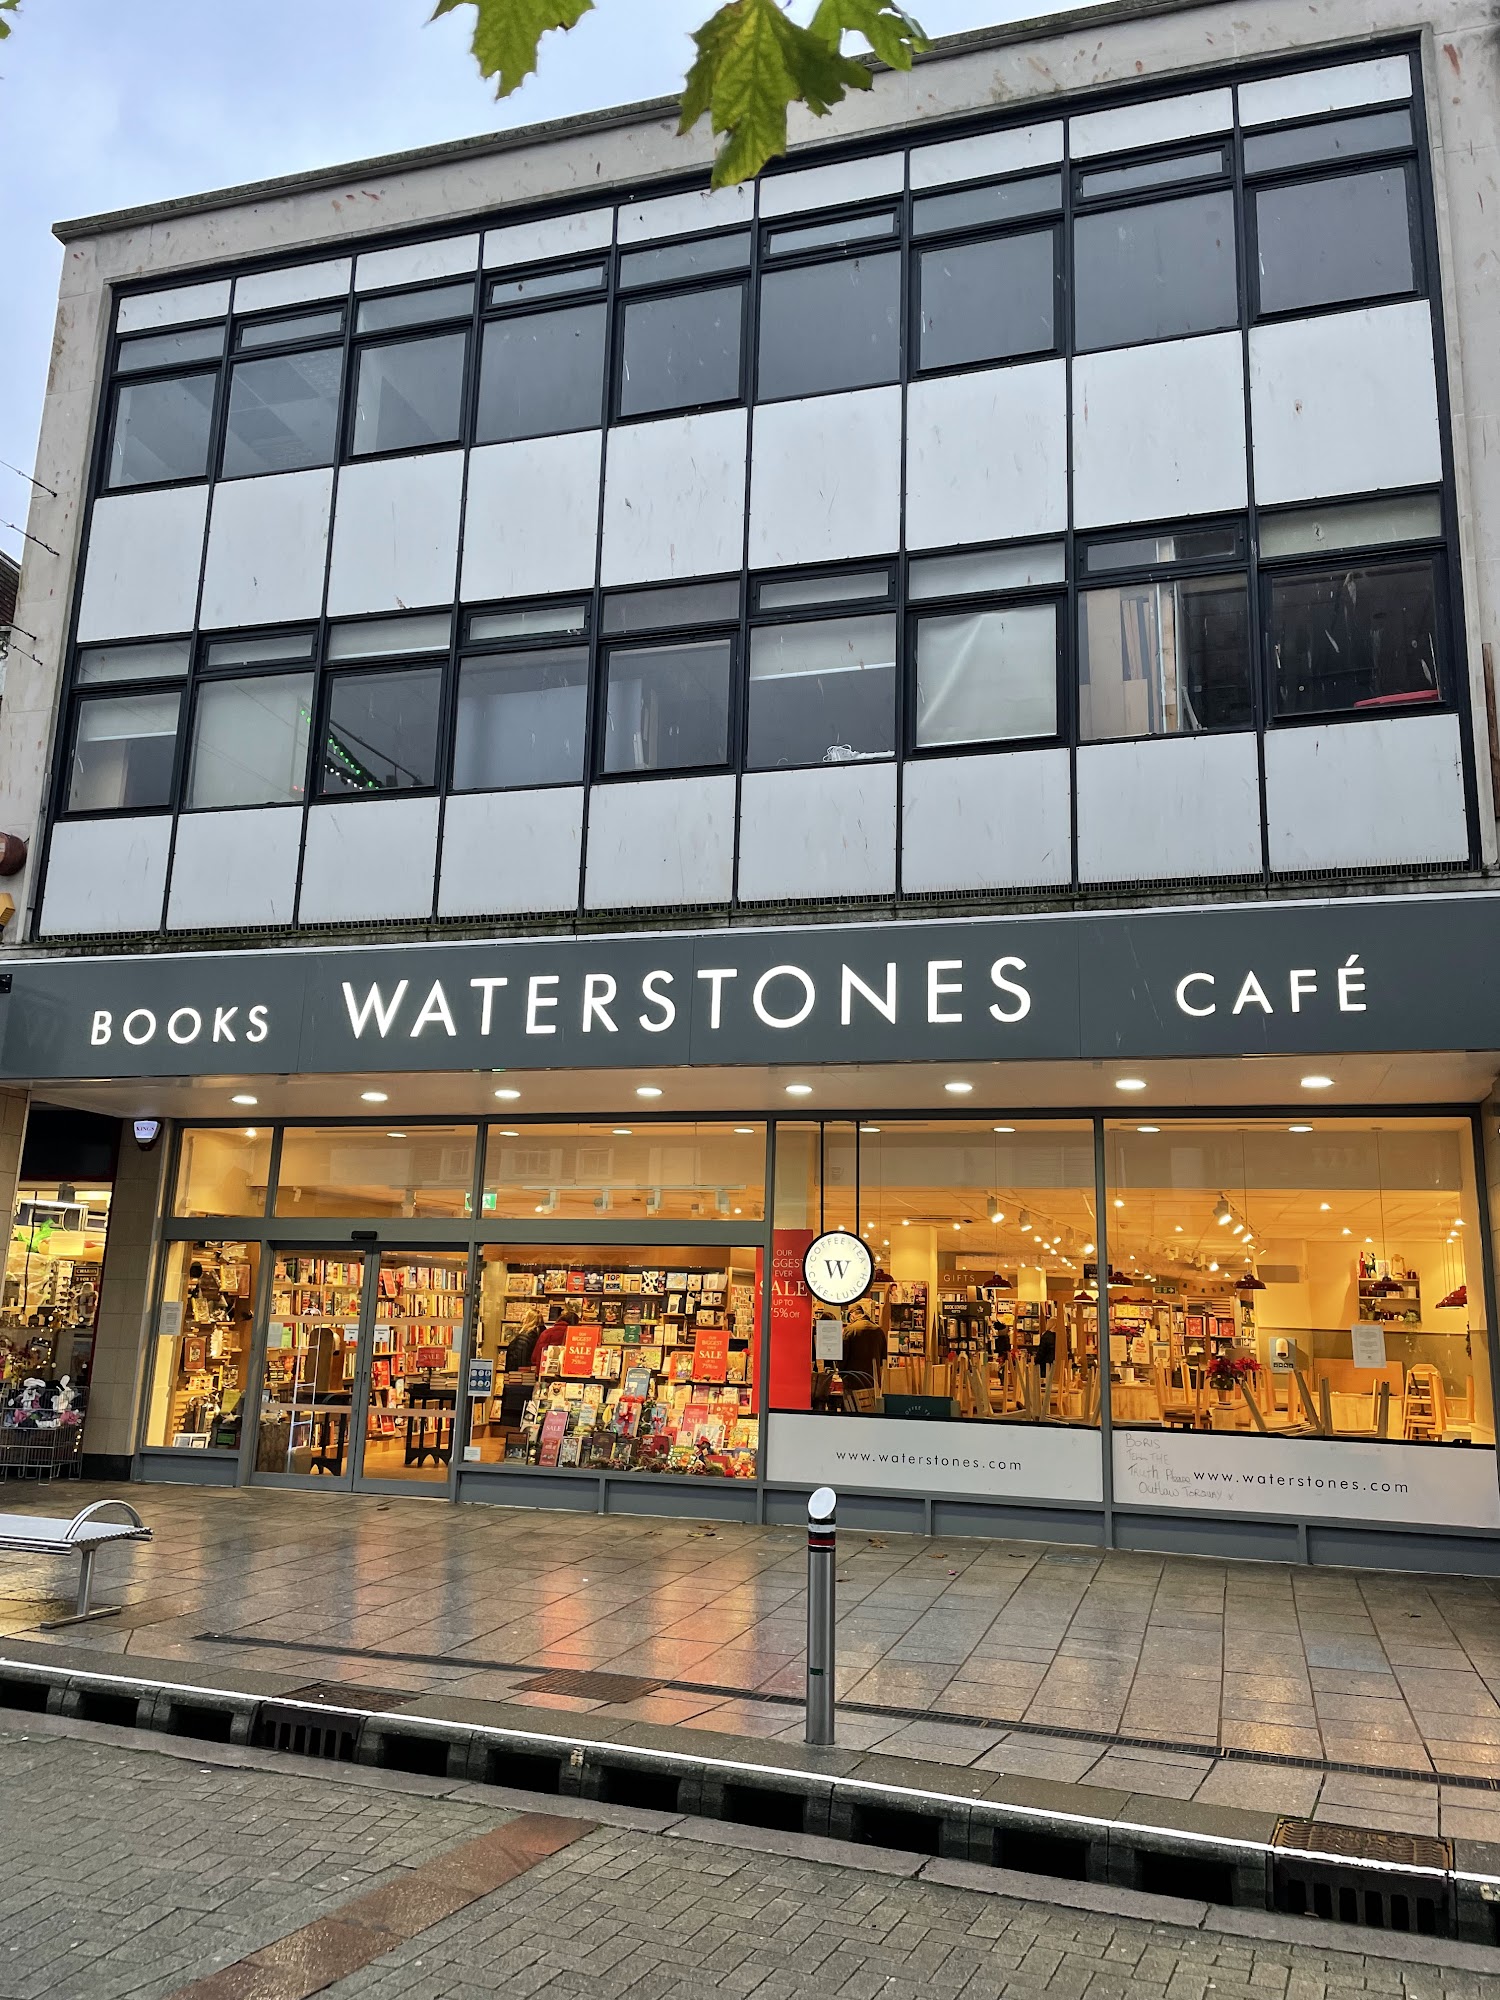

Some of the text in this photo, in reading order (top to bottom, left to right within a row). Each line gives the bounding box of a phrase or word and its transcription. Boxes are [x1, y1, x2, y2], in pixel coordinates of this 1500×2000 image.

[1176, 954, 1368, 1017] CAFÉ
[341, 956, 1032, 1039] WATERSTONES
[90, 1005, 268, 1046] BOOKS
[774, 1269, 793, 1277] EVER
[808, 1237, 868, 1300] COFFEE TEA LUNCH CAKE
[824, 1259, 851, 1280] W
[943, 1274, 975, 1283] GIFTS
[568, 1346, 592, 1355] SALE
[698, 1350, 723, 1359] SALE
[1125, 1433, 1161, 1449] BORIS
[836, 1451, 1022, 1471] www.waterstones.com
[1150, 1453, 1171, 1465] THE
[1193, 1471, 1409, 1493] www.waterstones.com
